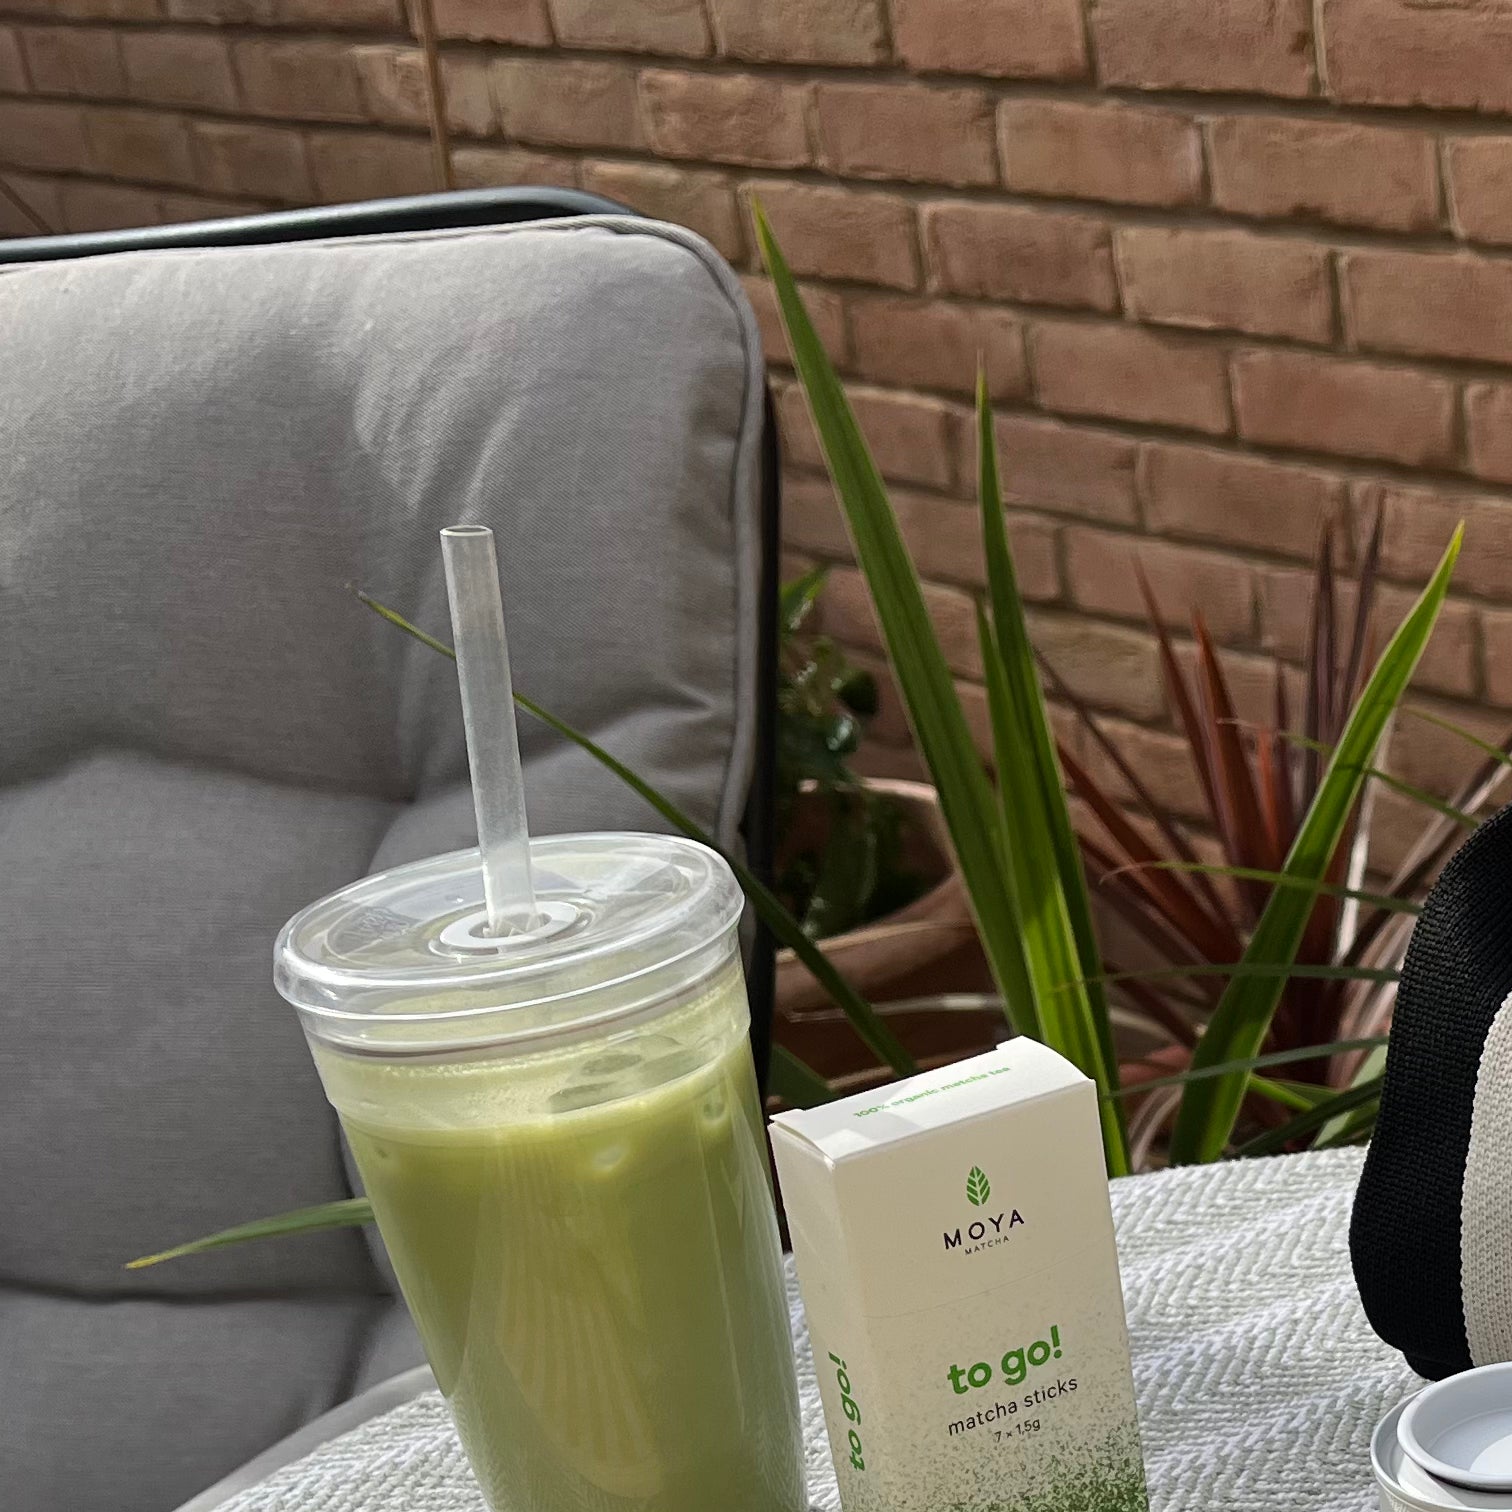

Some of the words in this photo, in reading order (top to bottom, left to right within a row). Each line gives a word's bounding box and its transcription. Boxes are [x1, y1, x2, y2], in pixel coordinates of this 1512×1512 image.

[853, 1104, 890, 1117] 100%
[891, 1088, 939, 1105] organic
[941, 1073, 988, 1090] matcha
[987, 1066, 1011, 1076] tea
[943, 1209, 1025, 1250] MOYA
[964, 1235, 1010, 1255] MATCHA
[947, 1362, 992, 1395] to
[1001, 1324, 1062, 1386] go!
[828, 1351, 861, 1426] go!
[948, 1401, 1018, 1436] matcha
[1023, 1378, 1078, 1408] sticks
[849, 1429, 865, 1472] to
[993, 1431, 1002, 1443] 7
